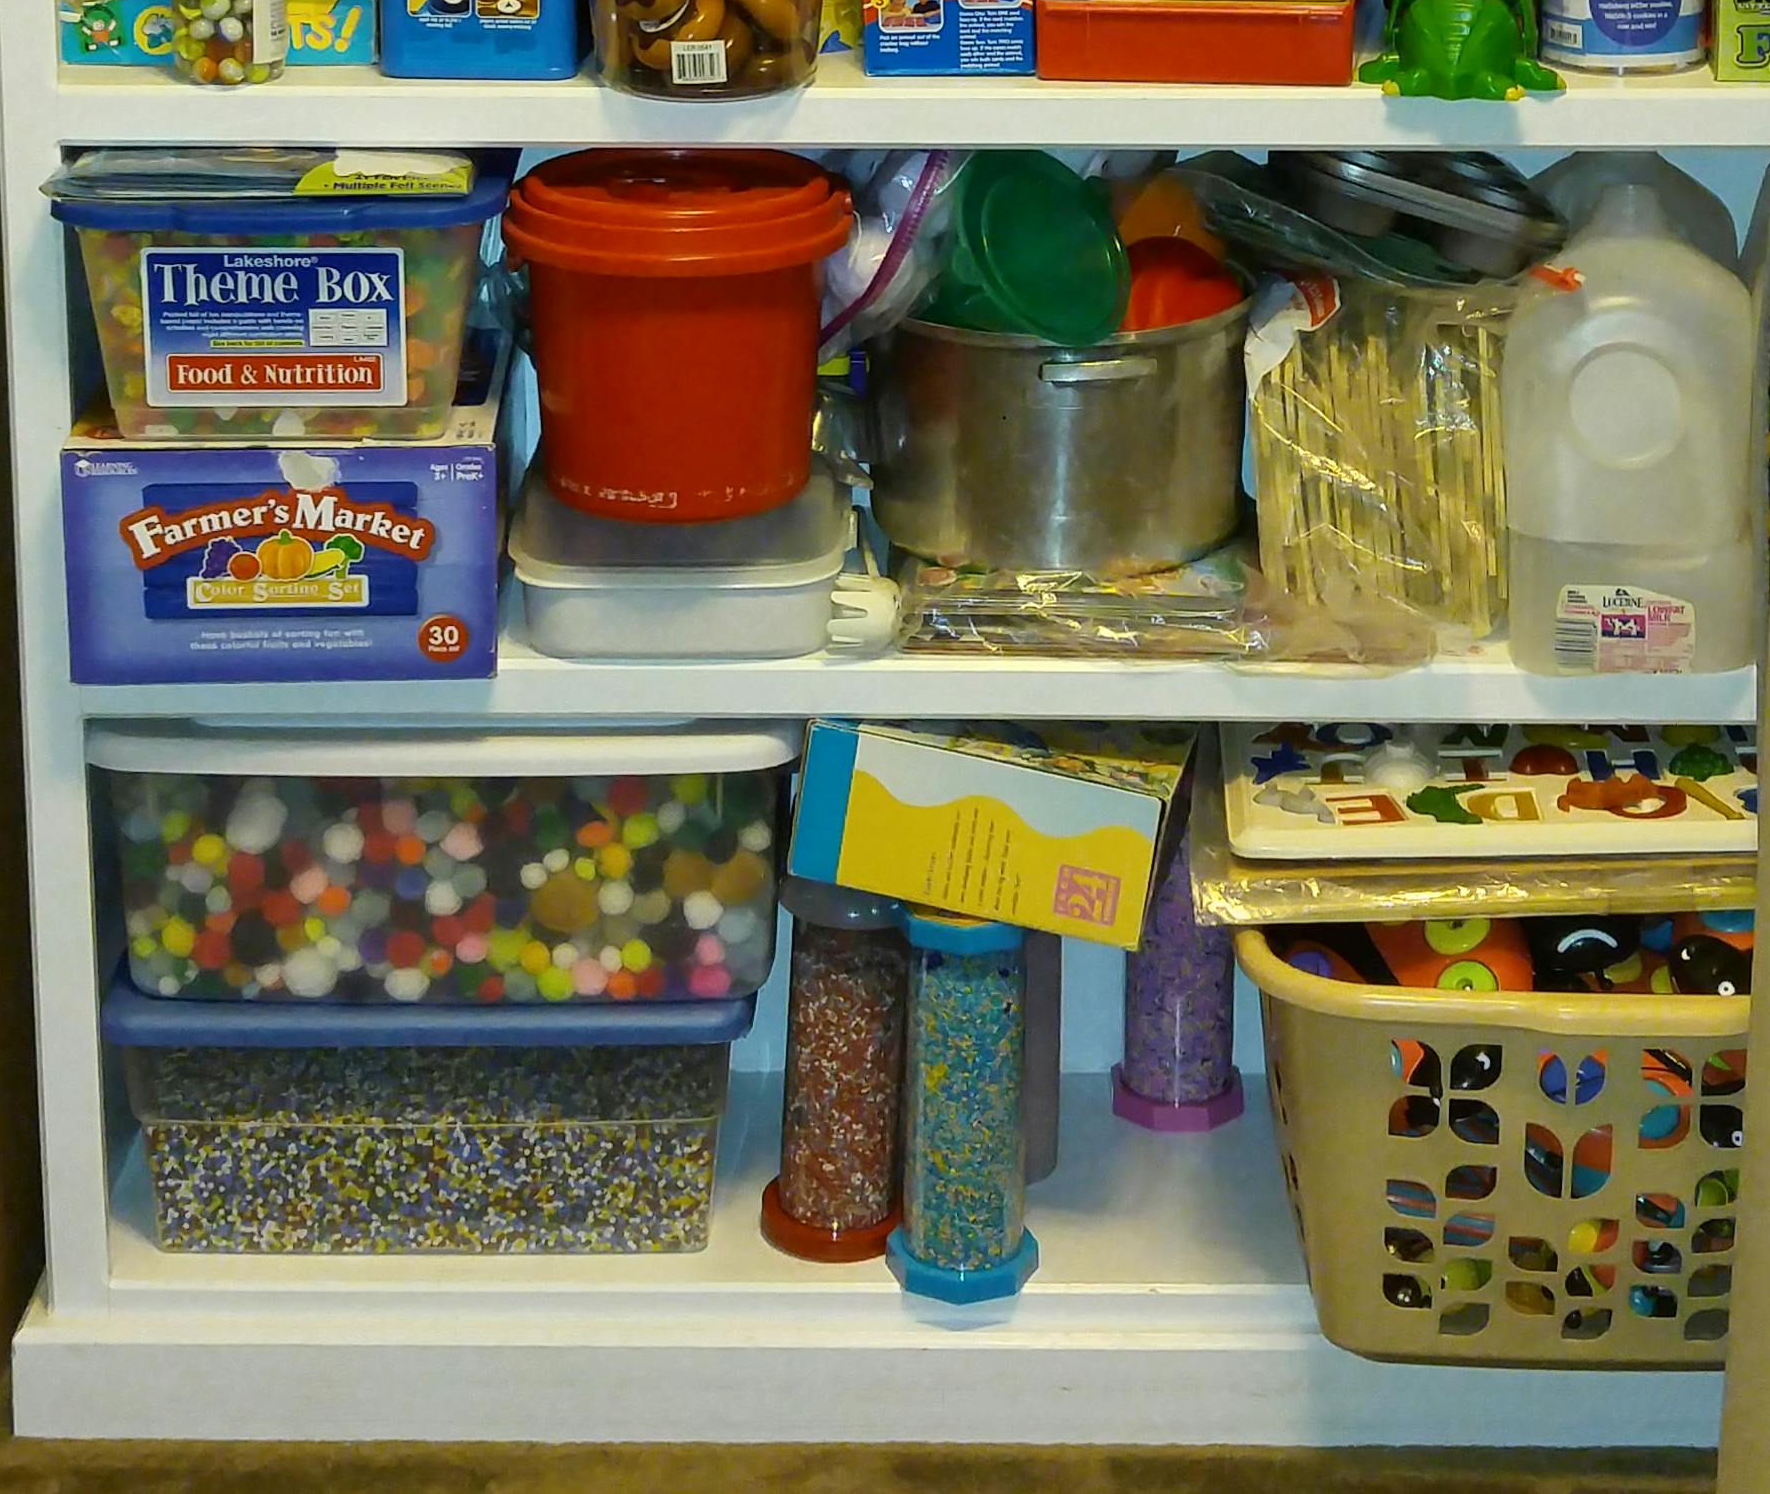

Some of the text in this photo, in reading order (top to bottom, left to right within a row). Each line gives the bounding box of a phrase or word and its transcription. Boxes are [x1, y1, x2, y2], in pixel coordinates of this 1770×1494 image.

[153, 262, 394, 306] Theme Box
[177, 363, 374, 385] Food & Nutrition
[128, 492, 425, 558] Farmer's Market
[428, 624, 460, 645] 30
